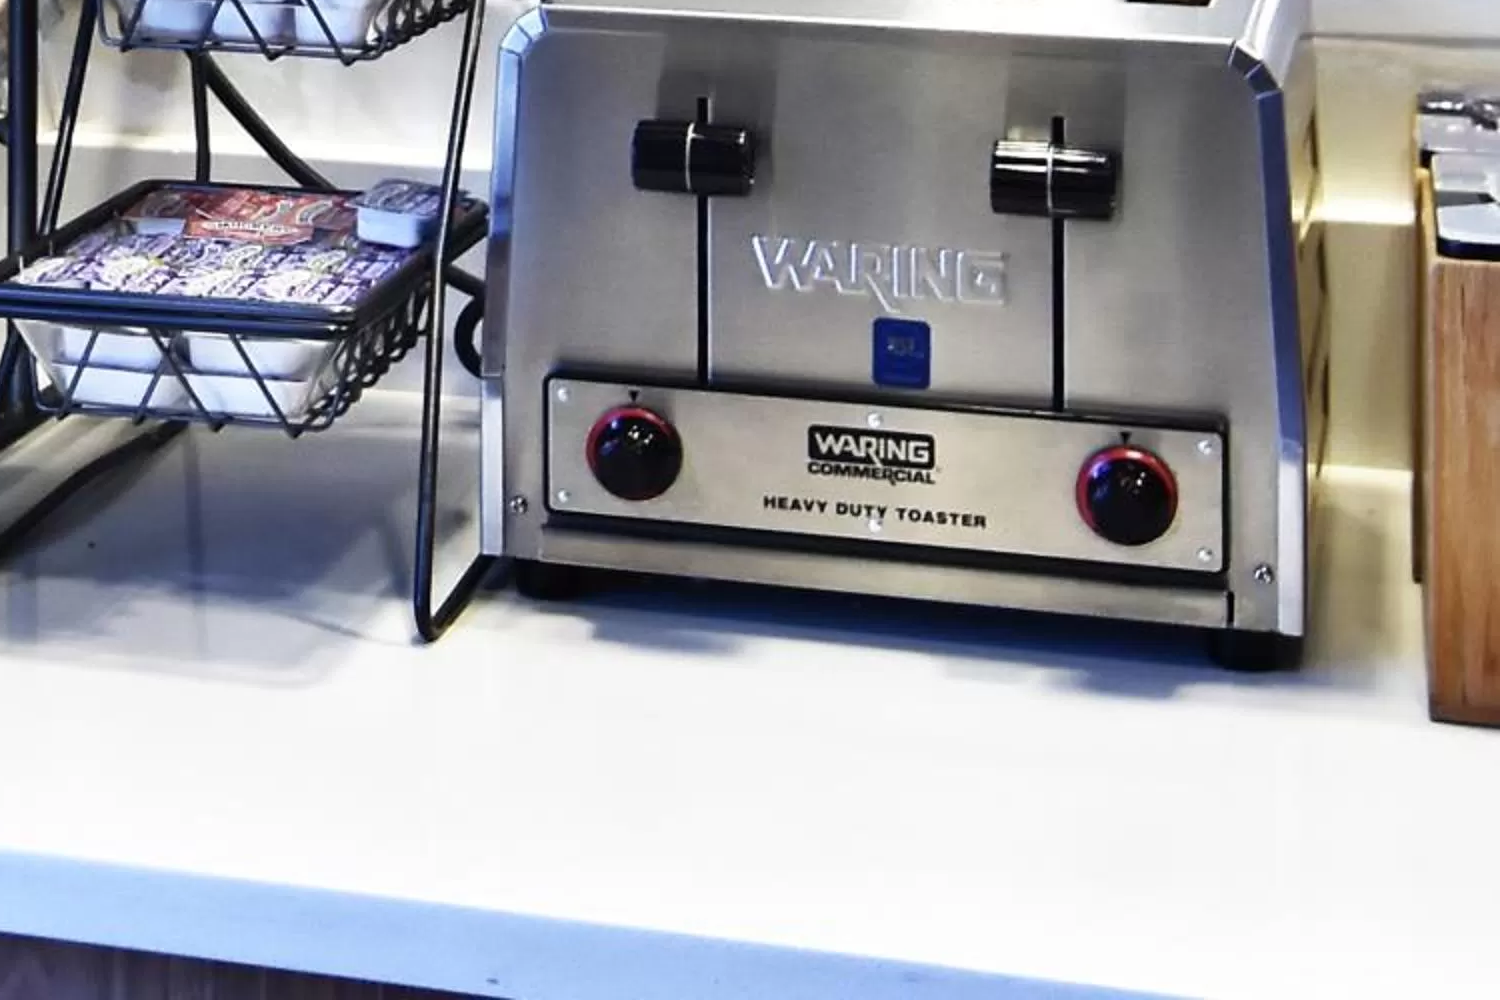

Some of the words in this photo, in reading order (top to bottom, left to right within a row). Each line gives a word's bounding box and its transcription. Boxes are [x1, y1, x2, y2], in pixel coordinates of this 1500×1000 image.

[751, 235, 1009, 313] WARING
[815, 432, 930, 468] WARING
[808, 461, 936, 486] COMMERCIAL
[763, 495, 828, 513] HEAVY
[836, 502, 887, 519] DUTY
[896, 507, 987, 529] TOASTER
